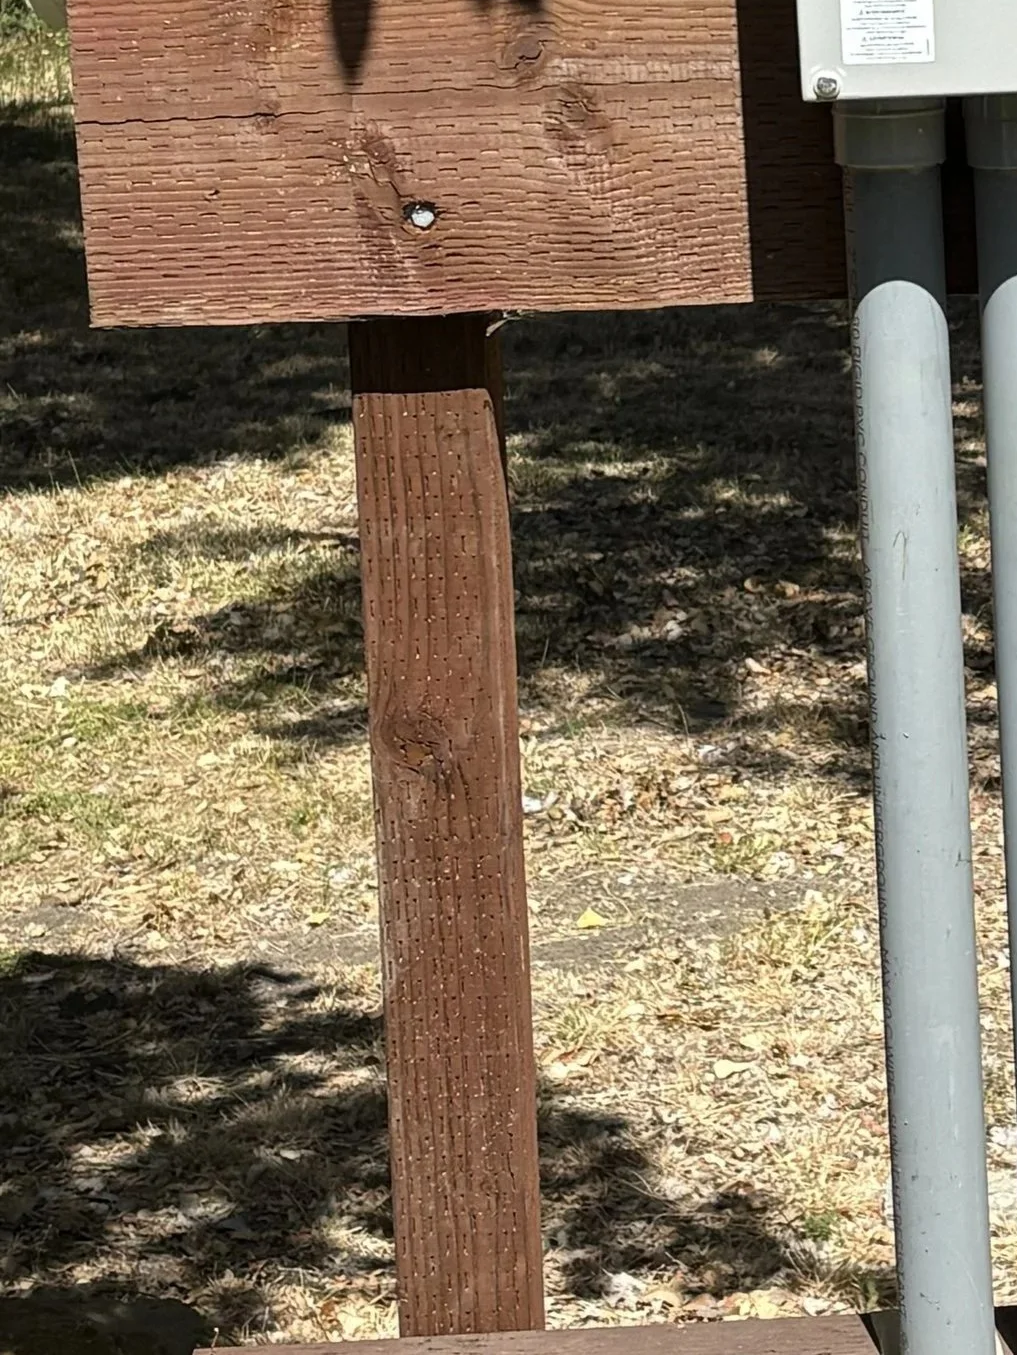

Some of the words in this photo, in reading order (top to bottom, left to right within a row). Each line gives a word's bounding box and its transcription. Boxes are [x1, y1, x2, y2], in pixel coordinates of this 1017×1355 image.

[852, 346, 863, 400] RIGID
[855, 405, 865, 447] PVC
[858, 451, 870, 544] CONDUIT
[871, 730, 880, 771] AND
[875, 775, 887, 929] UNDERGROUND
